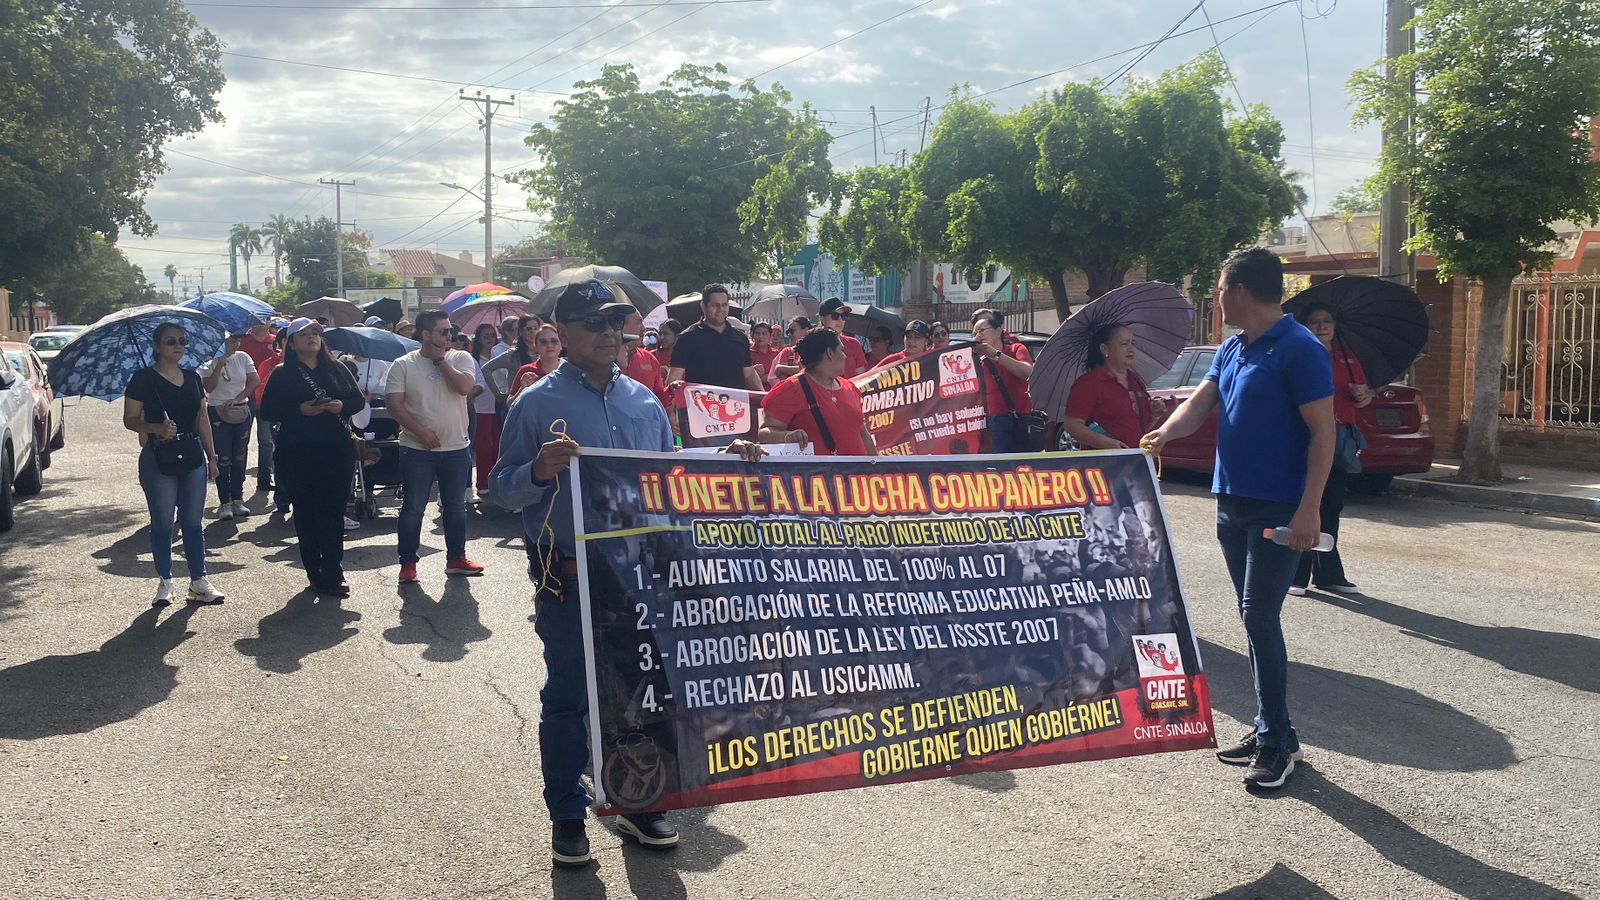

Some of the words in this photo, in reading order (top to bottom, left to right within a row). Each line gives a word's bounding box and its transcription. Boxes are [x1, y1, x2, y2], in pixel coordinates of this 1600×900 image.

[877, 361, 921, 390] MAYO
[942, 380, 976, 396] SINALOA
[946, 373, 969, 384] CNTE
[861, 379, 935, 413] OMBATIVO
[705, 422, 736, 433] CNTE
[868, 410, 894, 430] 2007
[914, 431, 927, 442] no
[928, 424, 956, 439] rueda
[956, 422, 967, 433] su
[923, 416, 935, 427] no
[935, 411, 953, 424] hay
[877, 441, 913, 457] SSSTE
[667, 466, 767, 514] ÚNETE
[769, 475, 793, 515] A
[793, 475, 833, 515] LA
[835, 472, 928, 516] LUCHA
[930, 465, 1087, 514] COMPAÑERO
[696, 522, 758, 547] APOYO
[760, 521, 816, 547] TOTAL
[820, 521, 843, 547] AL
[845, 520, 889, 546] PARO
[893, 519, 987, 546] INDEFINIDO
[989, 518, 1013, 542] DE
[1016, 516, 1039, 540] LA
[1042, 513, 1085, 538] CNTE
[668, 558, 768, 588] AUMENTO
[771, 558, 861, 584] SALARIAL
[864, 557, 899, 582] DEL
[901, 556, 957, 581] 100%
[959, 556, 982, 580] AL
[984, 554, 1006, 578] 07
[672, 588, 804, 628] ABROGACIÓN
[807, 592, 833, 618] DE
[835, 592, 861, 617] LA
[864, 588, 951, 617] REFORMA
[951, 582, 1051, 613] EDUCATIVA
[1050, 576, 1152, 607] PEÑA-AMLO
[676, 625, 811, 668] ABROGACIÓN
[814, 629, 840, 655] DE
[843, 628, 868, 653] LA
[871, 626, 906, 651] LEY
[910, 623, 944, 650] DEL
[948, 619, 1011, 648] ISSSTE
[1012, 617, 1060, 645] 2007
[684, 672, 785, 709] RECHAZO
[791, 669, 817, 698] AL
[821, 662, 921, 695] USICAMM.
[1147, 678, 1186, 700] CNTE
[763, 712, 876, 764] DERECHOS
[879, 707, 907, 738] SE
[911, 684, 1026, 732] DEFIENDEN,
[862, 724, 961, 779] GOBIERNE
[965, 718, 1023, 757] QUIEN
[1026, 698, 1122, 743] GOBIÉRNE!
[1134, 725, 1163, 739] CNTE
[1165, 721, 1209, 737] SINALOA
